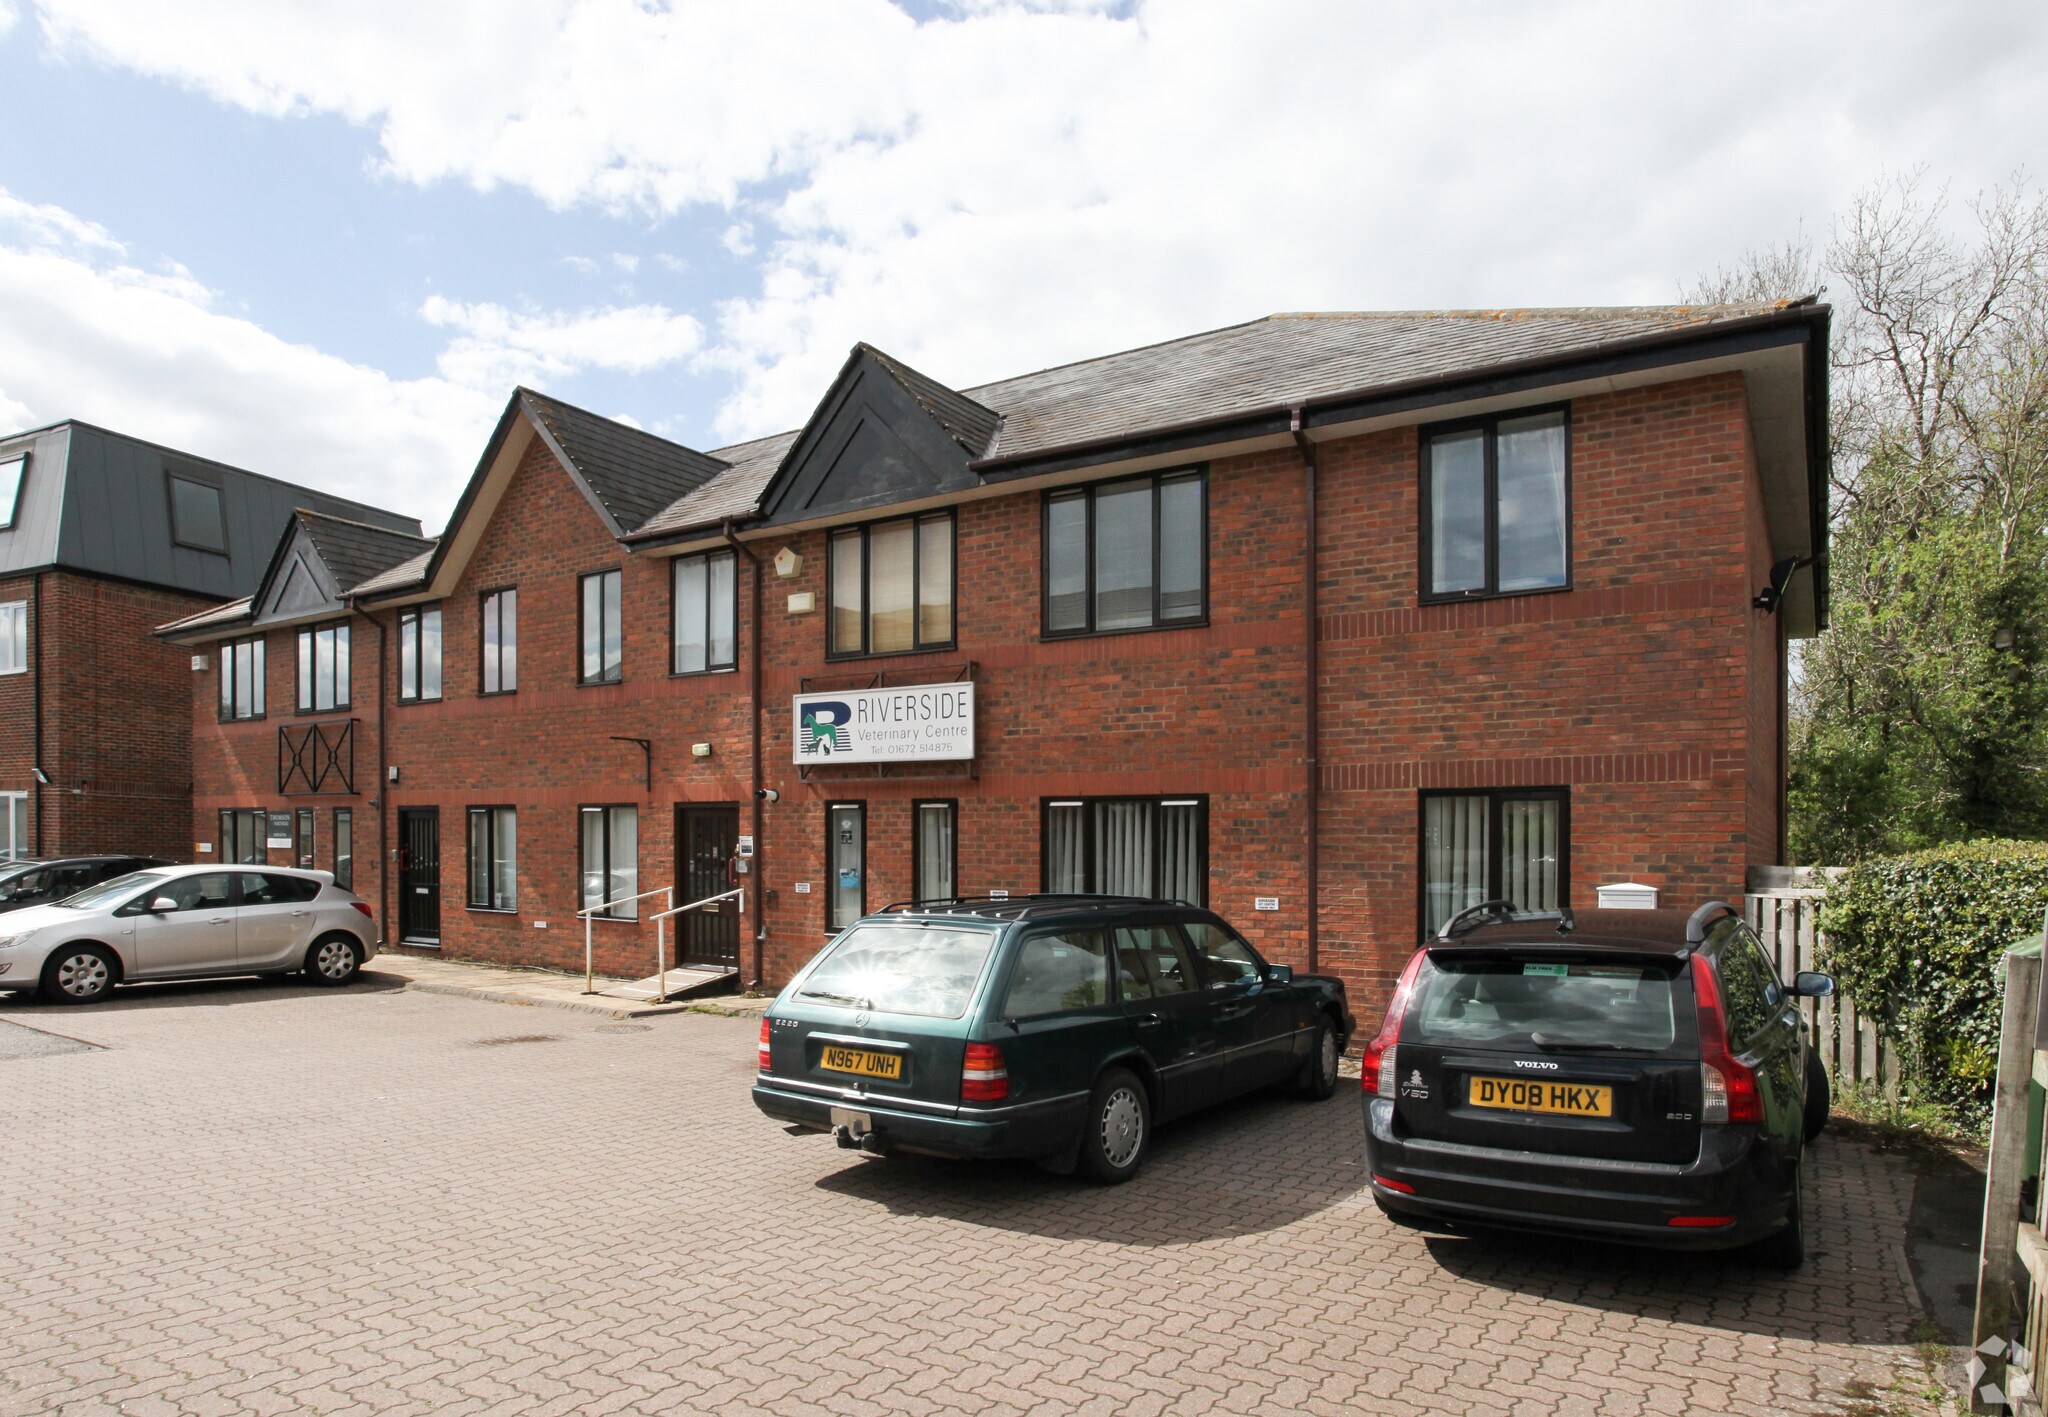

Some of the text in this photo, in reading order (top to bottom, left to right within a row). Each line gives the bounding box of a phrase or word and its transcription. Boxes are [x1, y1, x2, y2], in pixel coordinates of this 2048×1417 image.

[858, 691, 967, 723] RIVERSIDE
[857, 725, 968, 741] Veterinary Centre
[888, 744, 915, 754] 01672
[919, 743, 953, 753] 514875
[775, 1018, 799, 1028] E220
[827, 1048, 896, 1075] N967 UNH
[1514, 1060, 1558, 1070] VOLVO
[1401, 1087, 1429, 1099] V50
[1480, 1080, 1600, 1111] DY08 HKX
